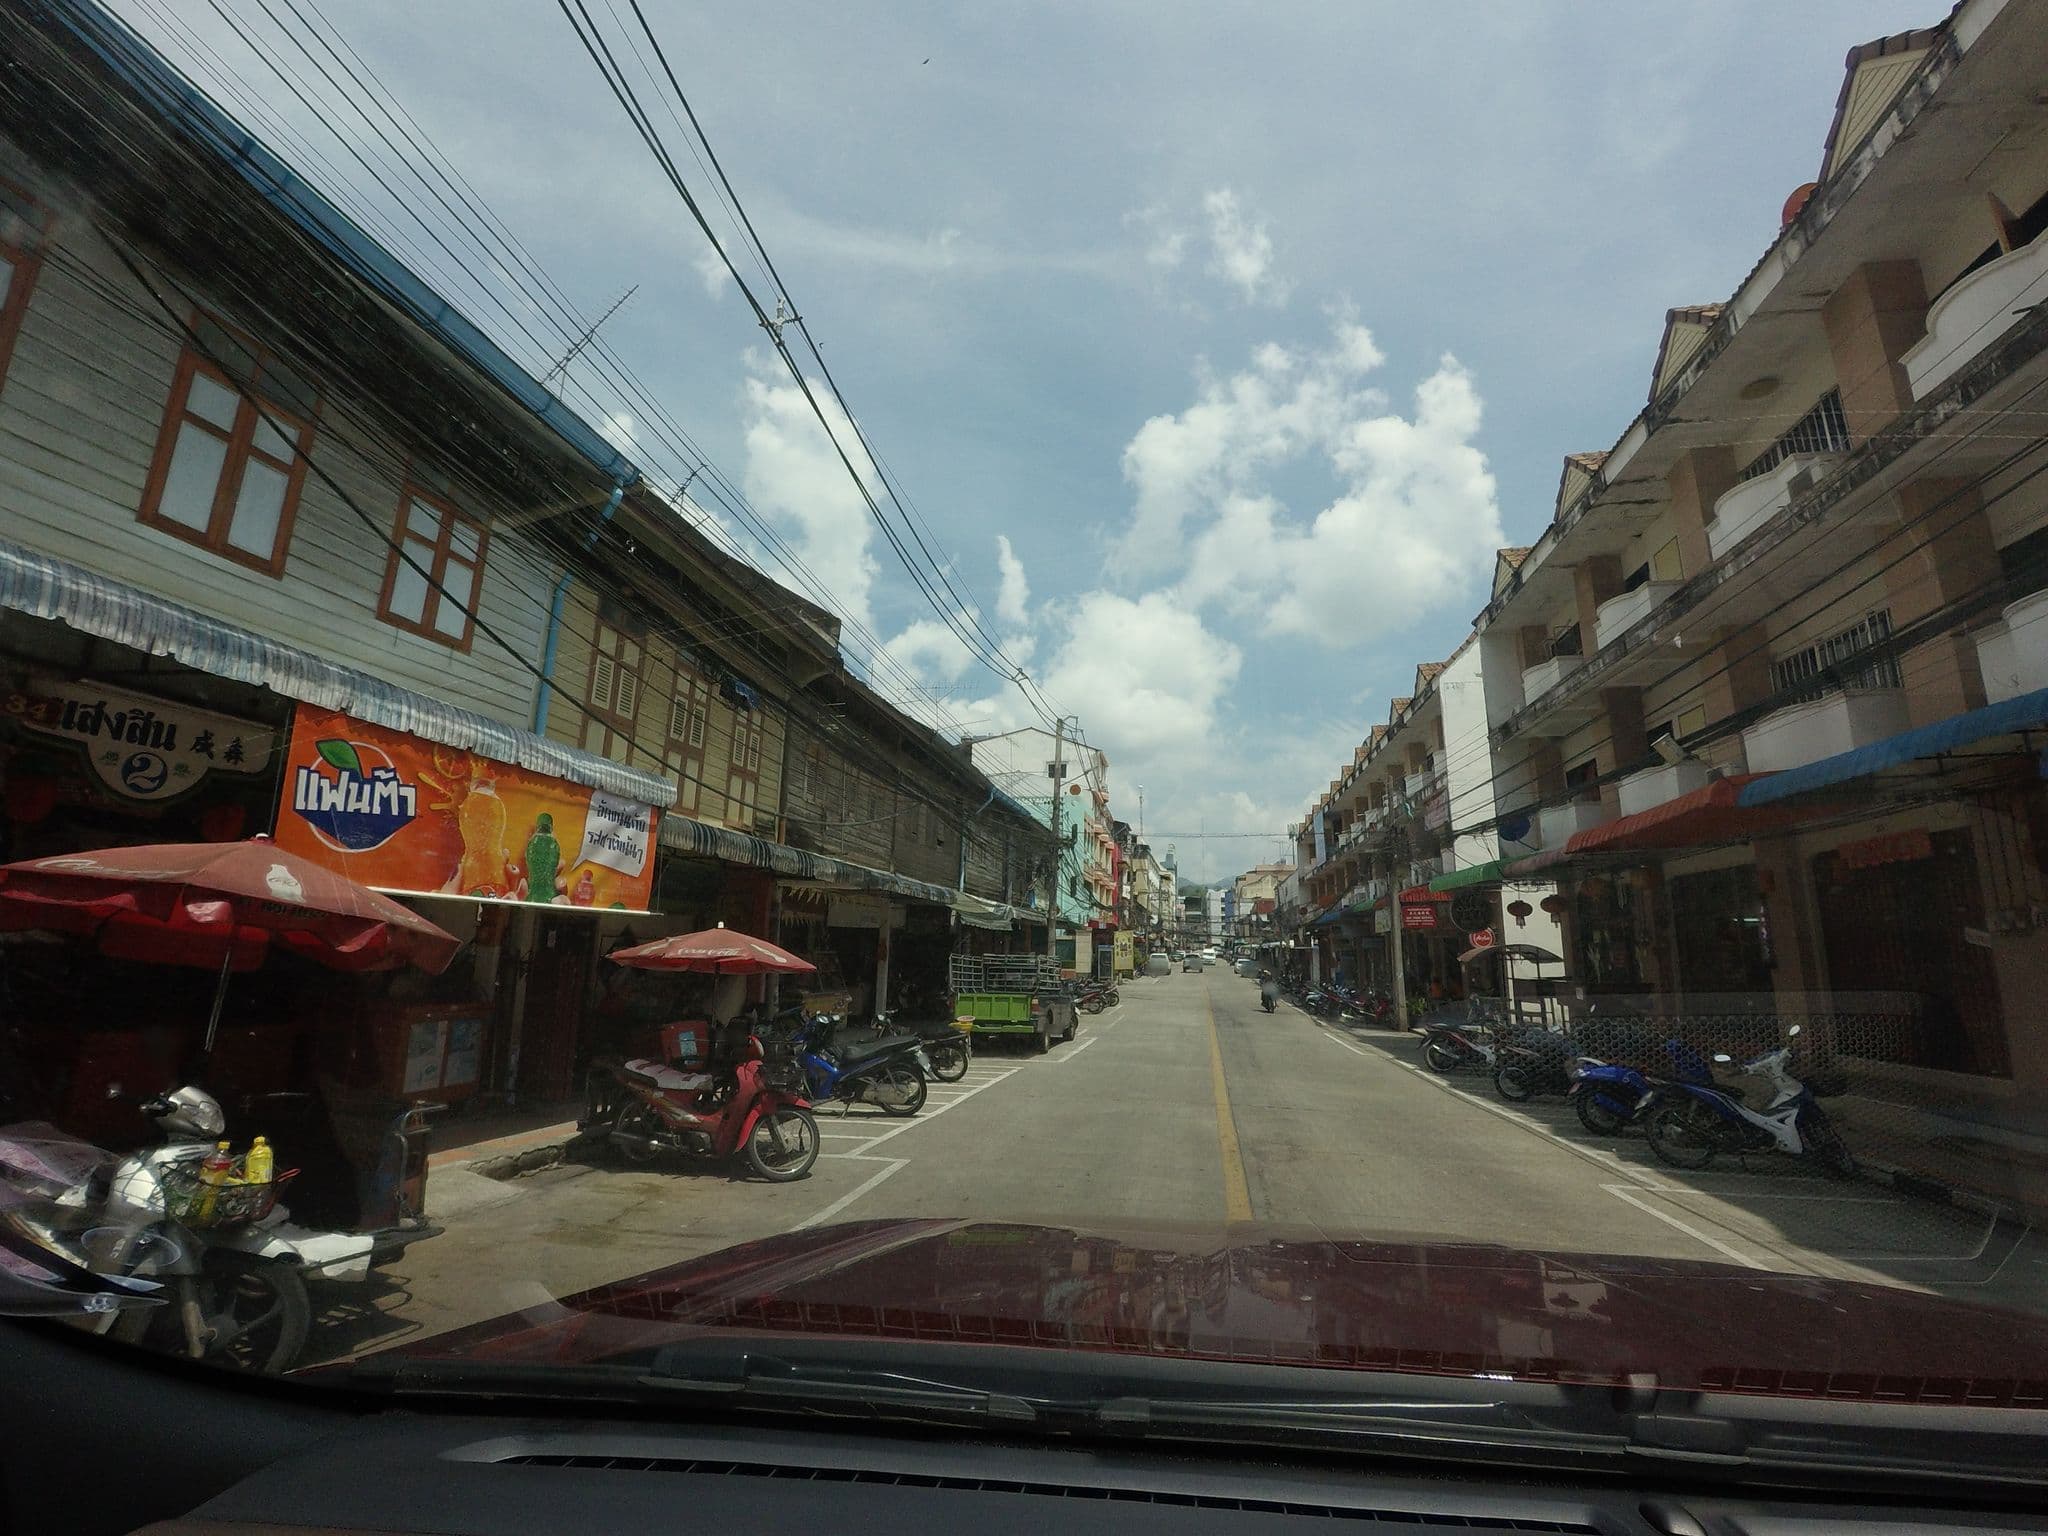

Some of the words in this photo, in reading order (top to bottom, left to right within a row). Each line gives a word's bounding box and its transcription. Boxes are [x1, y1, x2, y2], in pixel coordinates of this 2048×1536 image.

[125, 755, 167, 791] 2
[295, 767, 417, 818] แฟนต้า
